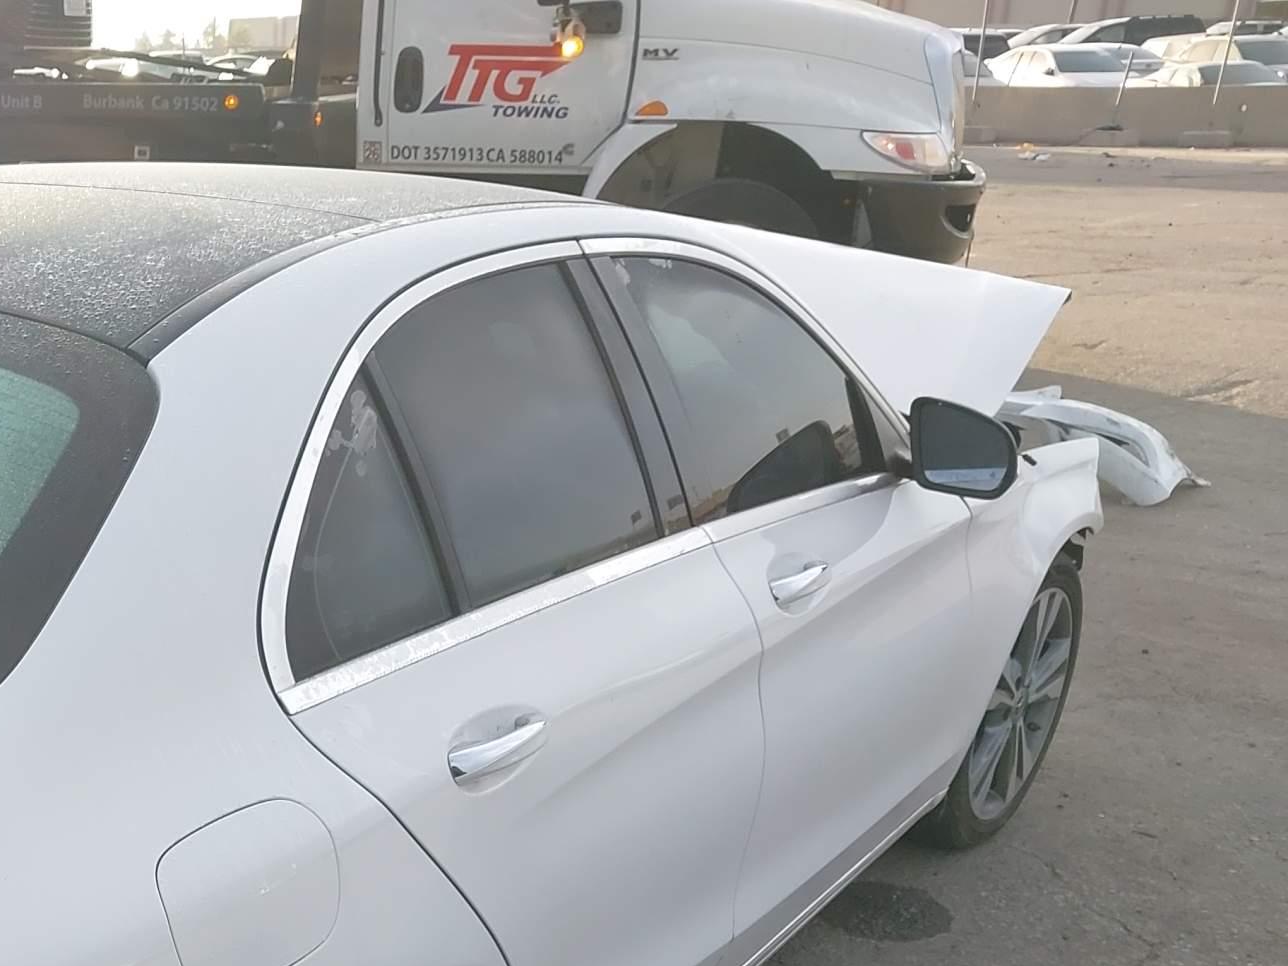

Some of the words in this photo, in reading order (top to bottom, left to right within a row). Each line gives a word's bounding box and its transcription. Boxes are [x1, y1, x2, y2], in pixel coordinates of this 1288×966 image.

[643, 48, 678, 58] MV
[443, 43, 572, 103] TTG
[1, 93, 30, 108] Unit
[33, 94, 42, 109] B
[83, 93, 145, 109] Burbank
[152, 95, 170, 110] Ca
[173, 96, 218, 112] 91502
[531, 93, 560, 105] LLC.
[492, 104, 569, 119] TOWING
[391, 145, 420, 160] DOT
[424, 146, 484, 162] 3571913
[486, 147, 505, 163] CA
[510, 149, 563, 164] 588014
